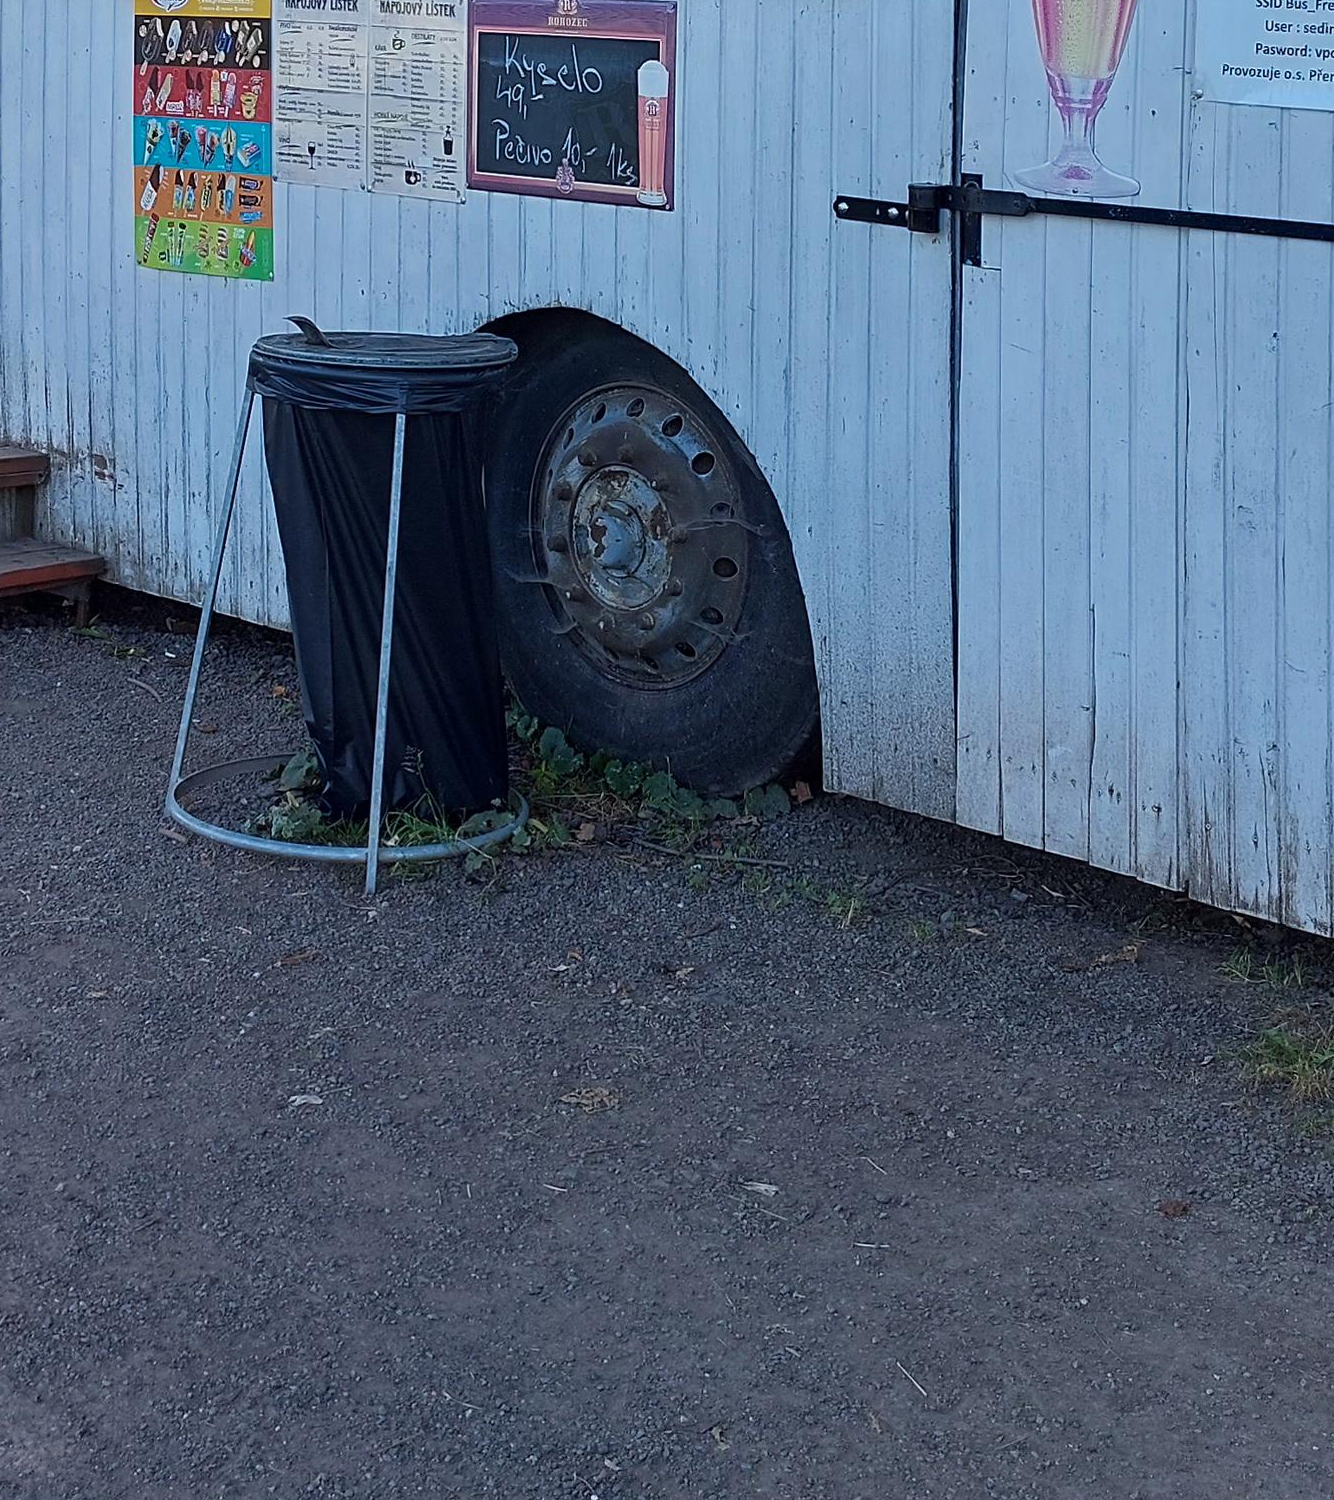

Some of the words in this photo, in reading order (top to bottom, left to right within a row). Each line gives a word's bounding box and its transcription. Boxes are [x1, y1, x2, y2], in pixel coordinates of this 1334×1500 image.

[426, 0, 456, 18] LÍSTEK
[547, 16, 588, 28] ROHOZEC
[1265, 19, 1293, 33] User
[1255, 42, 1312, 58] Pasword:
[504, 35, 603, 97] Kyselo
[1221, 63, 1281, 81] Provozuje
[1284, 70, 1305, 81] o.s.
[491, 118, 552, 166] Pečivo
